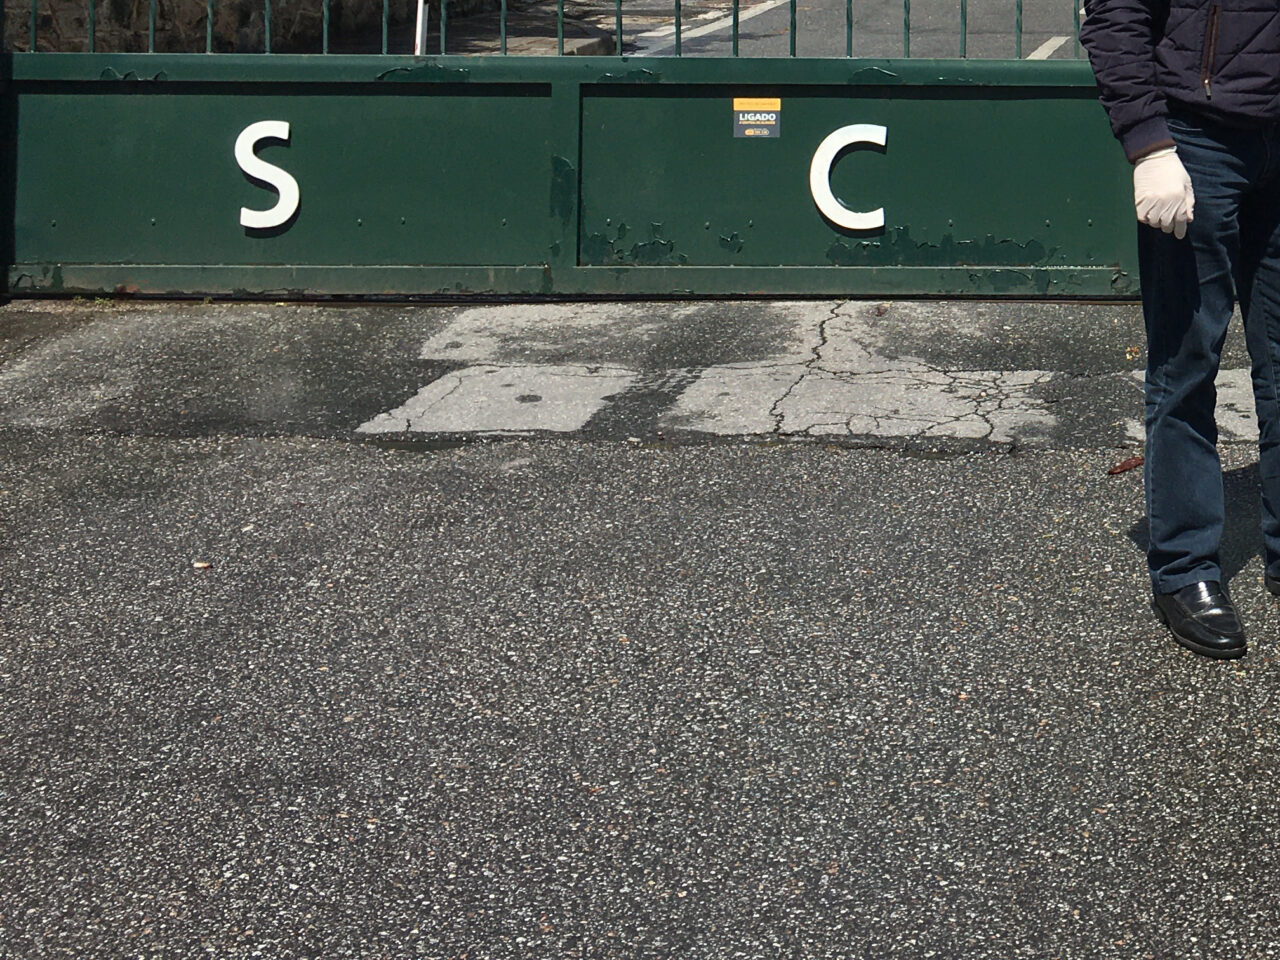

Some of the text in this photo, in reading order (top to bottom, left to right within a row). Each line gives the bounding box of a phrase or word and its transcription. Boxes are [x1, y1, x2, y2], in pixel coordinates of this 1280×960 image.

[739, 113, 776, 121] LIGADO
[234, 120, 300, 229] S
[809, 123, 888, 230] C
